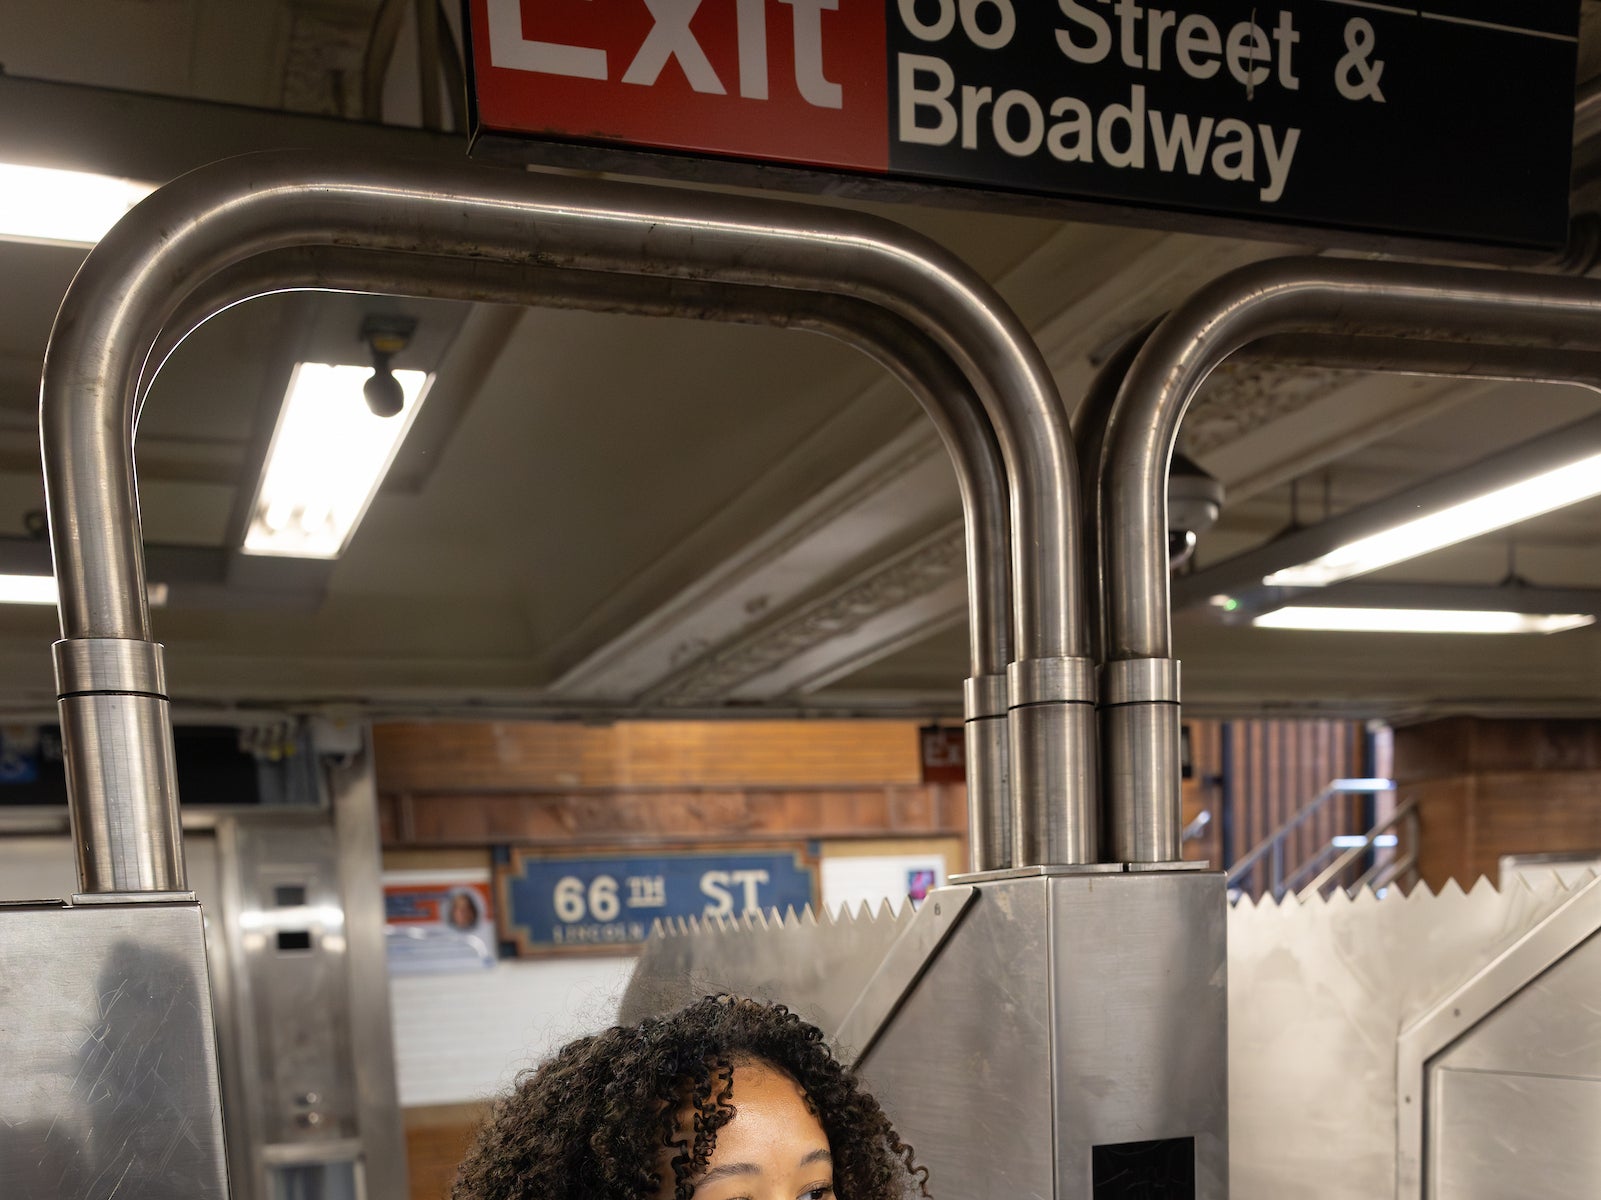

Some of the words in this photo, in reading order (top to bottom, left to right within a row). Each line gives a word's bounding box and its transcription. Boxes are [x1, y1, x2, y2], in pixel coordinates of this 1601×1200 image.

[1055, 0, 1300, 90] Street
[1334, 17, 1386, 103] &
[898, 51, 1301, 202] Broadway
[554, 875, 620, 923] 66
[700, 869, 769, 917] ST
